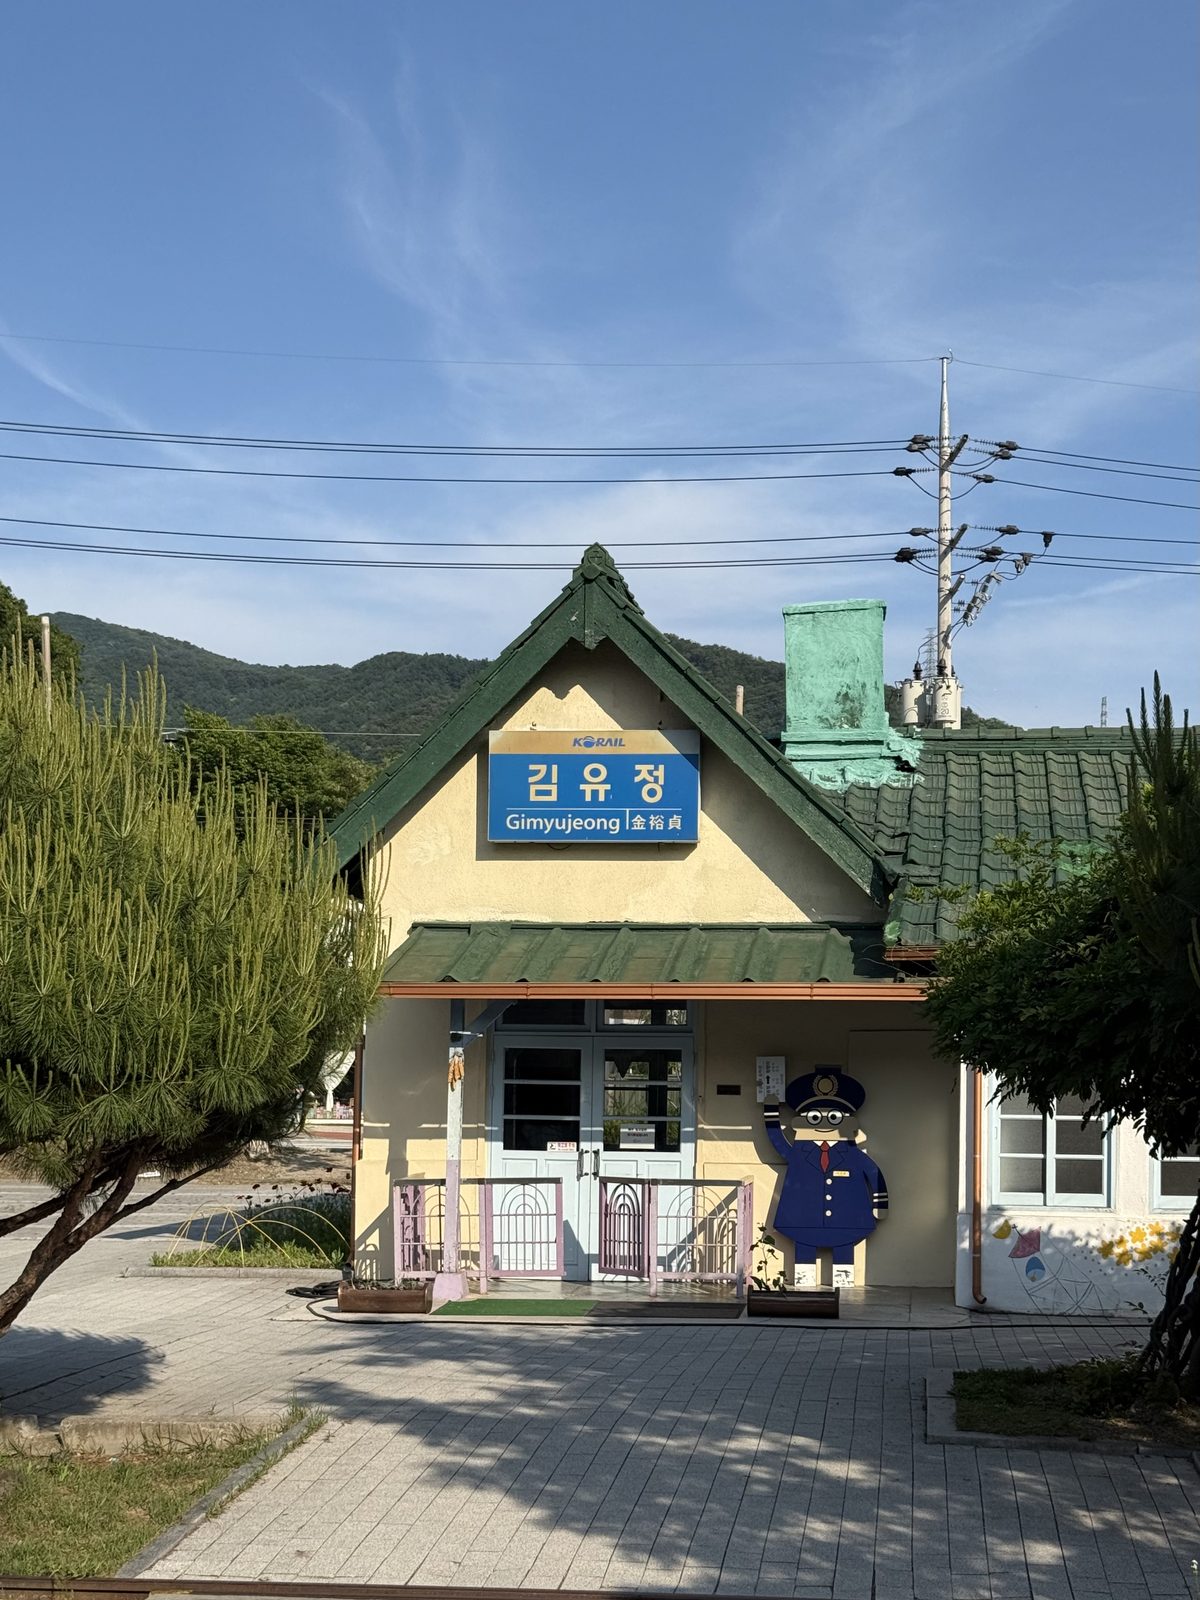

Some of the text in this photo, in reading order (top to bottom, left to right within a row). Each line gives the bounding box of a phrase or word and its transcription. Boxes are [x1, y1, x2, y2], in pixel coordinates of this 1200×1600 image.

[572, 735, 626, 748] KORAIL
[506, 813, 620, 834] Gimyujeong
[631, 814, 683, 831] 金裕貞
